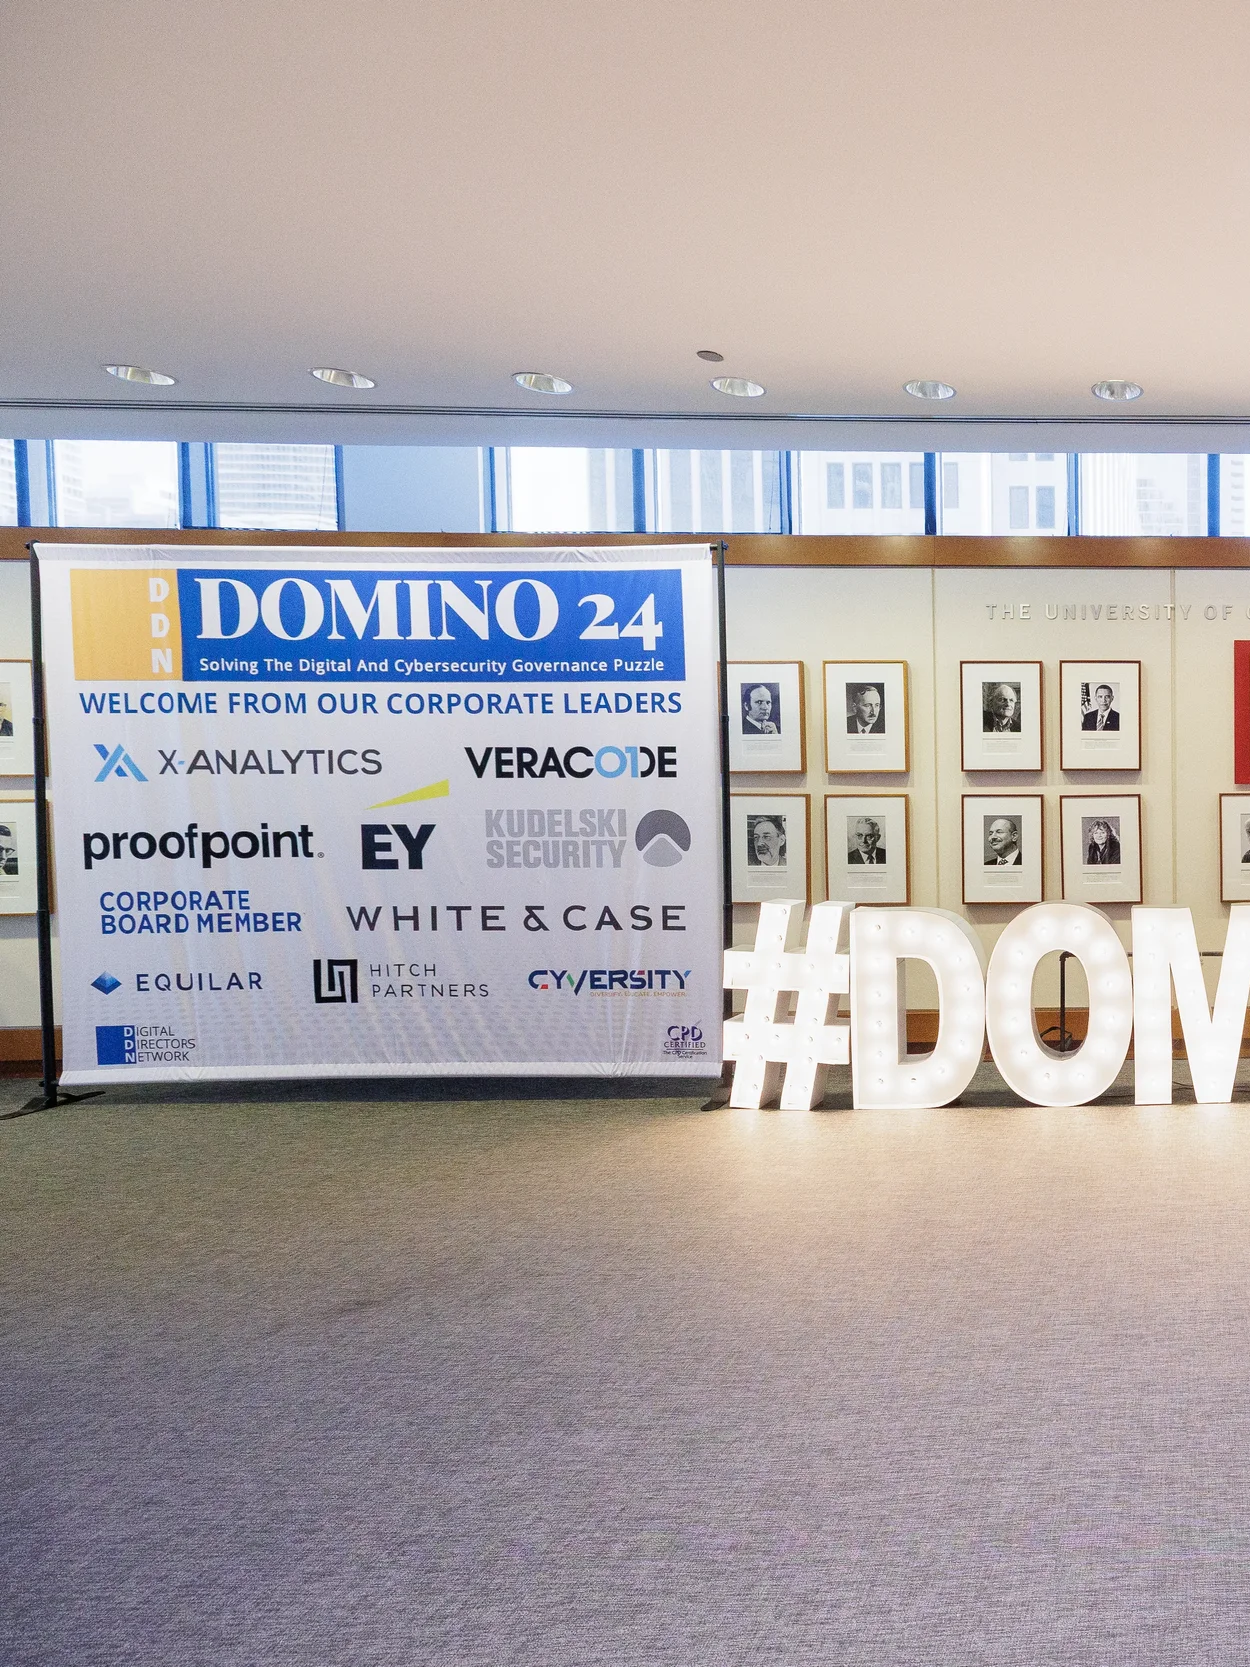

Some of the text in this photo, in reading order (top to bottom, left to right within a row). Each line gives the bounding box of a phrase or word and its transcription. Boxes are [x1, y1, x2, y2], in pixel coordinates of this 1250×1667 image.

[194, 578, 663, 650] DOMINO 24
[985, 603, 1031, 620] THE
[1045, 603, 1192, 621] UNIVERSITY
[1204, 604, 1233, 621] OF
[199, 658, 664, 677] Solving The Digital And Cybersecurity Governance Puzzle
[79, 692, 682, 715] WELCOME FROM OUR CORPORATE LEADERS
[158, 749, 383, 775] X-ANALYTICS
[485, 808, 627, 838] KUDELSKI
[83, 822, 314, 869] proofpoint
[361, 824, 436, 869] EY
[486, 839, 627, 868] SECURITY
[100, 890, 250, 911] CORPORATE
[101, 911, 302, 934] BOARD MEMBER
[346, 904, 686, 931] WHITE & CASE
[136, 971, 263, 991] EQUILAR
[369, 963, 437, 977] HITCH
[372, 984, 489, 997] PARTNERS
[528, 969, 692, 996] CYVERSITY
[123, 1026, 175, 1037] DIGITAL
[667, 1025, 703, 1041] CPD
[124, 1038, 196, 1050] DIRECTORS
[125, 1051, 190, 1063] NETWORK
